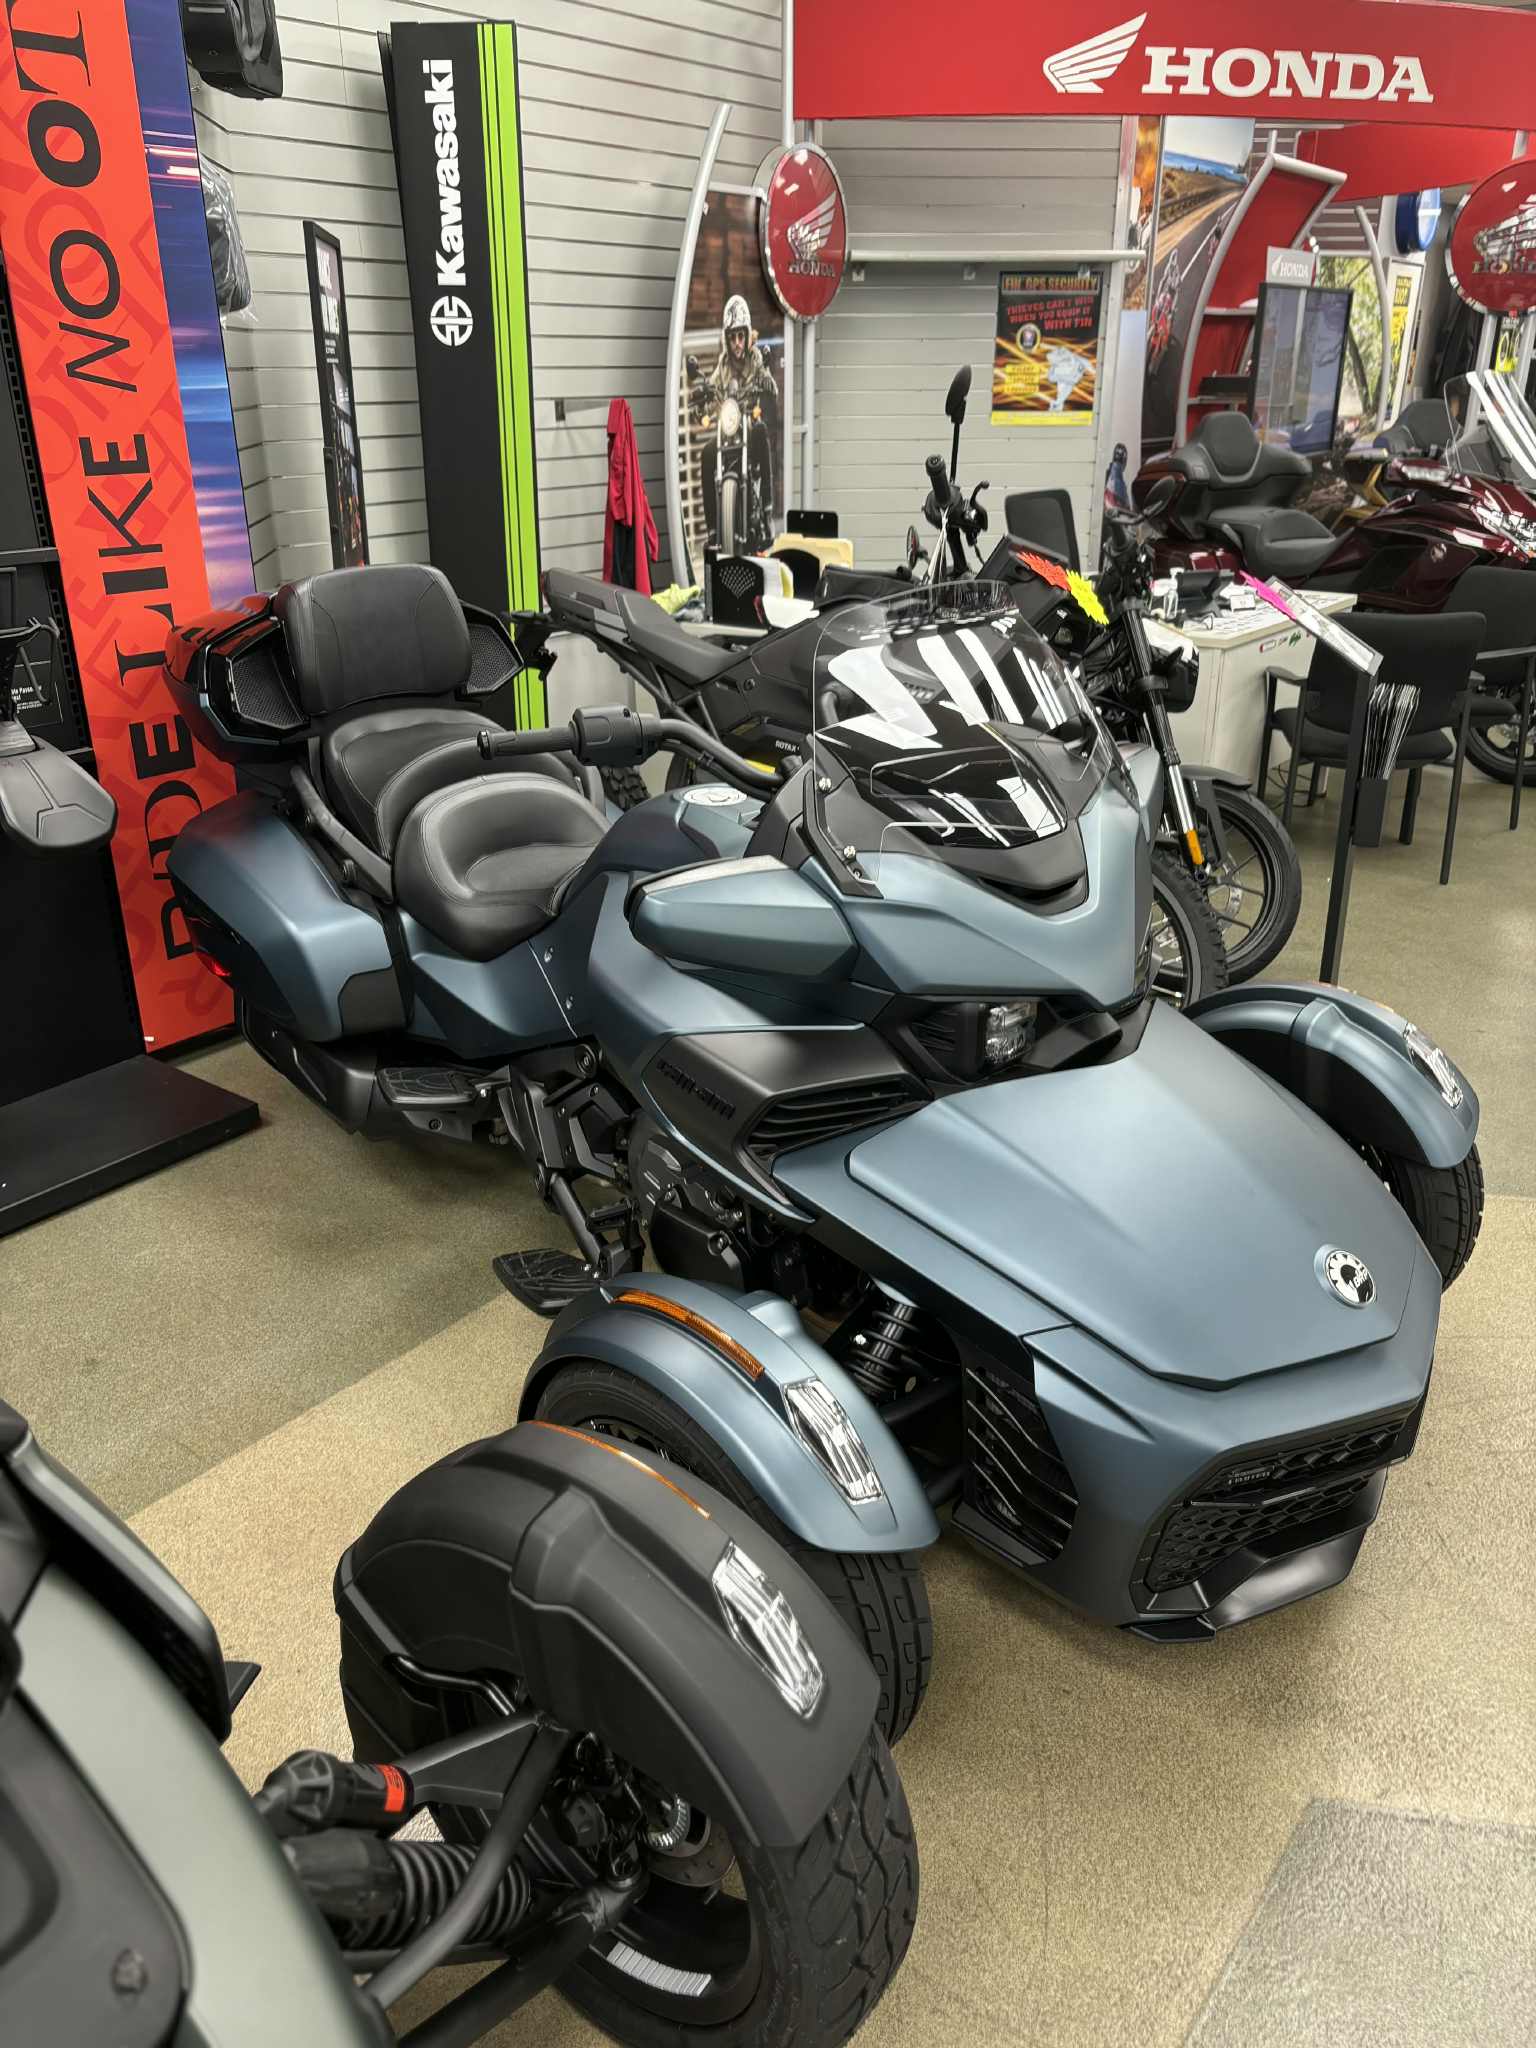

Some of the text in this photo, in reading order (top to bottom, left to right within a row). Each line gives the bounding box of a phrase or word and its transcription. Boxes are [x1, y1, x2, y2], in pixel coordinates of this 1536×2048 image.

[1141, 46, 1434, 103] HONDA
[422, 59, 466, 286] Kawasaki
[787, 260, 836, 278] HONDA
[1280, 261, 1310, 279] HONDA
[49, 228, 137, 393] NO
[1043, 318, 1072, 330] WITH
[775, 739, 797, 752] ROTAX
